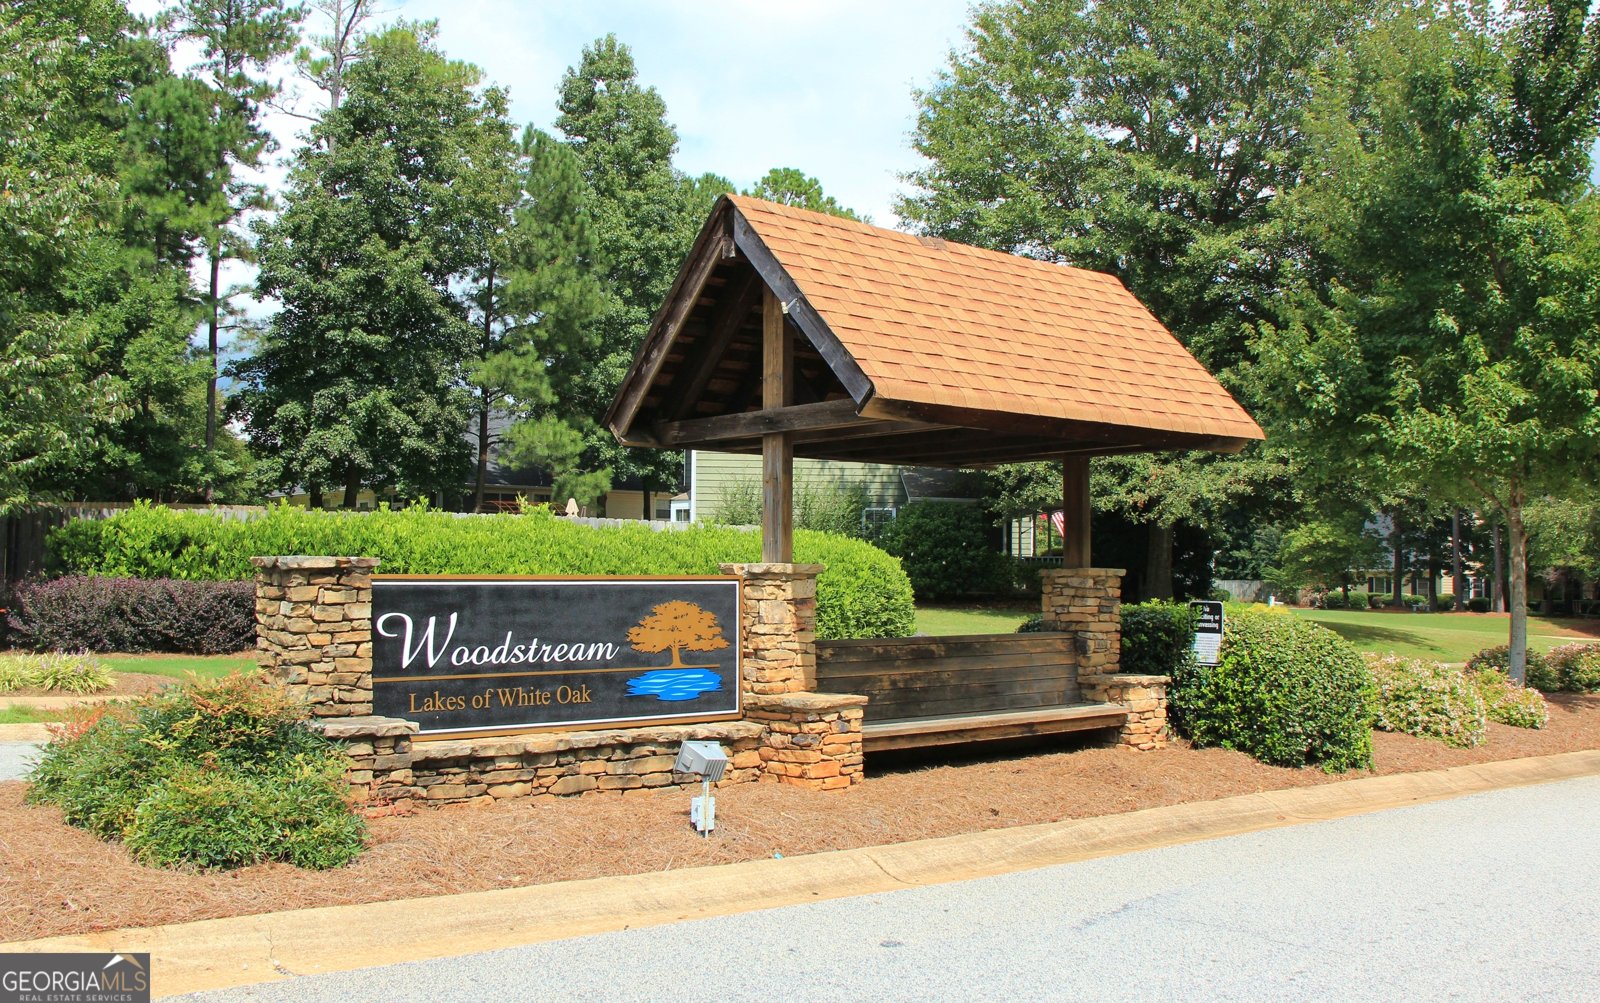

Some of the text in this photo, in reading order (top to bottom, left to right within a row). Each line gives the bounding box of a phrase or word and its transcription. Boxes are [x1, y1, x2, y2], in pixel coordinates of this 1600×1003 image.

[376, 612, 619, 669] Woodstream
[409, 684, 592, 713] Lakes of White Oak
